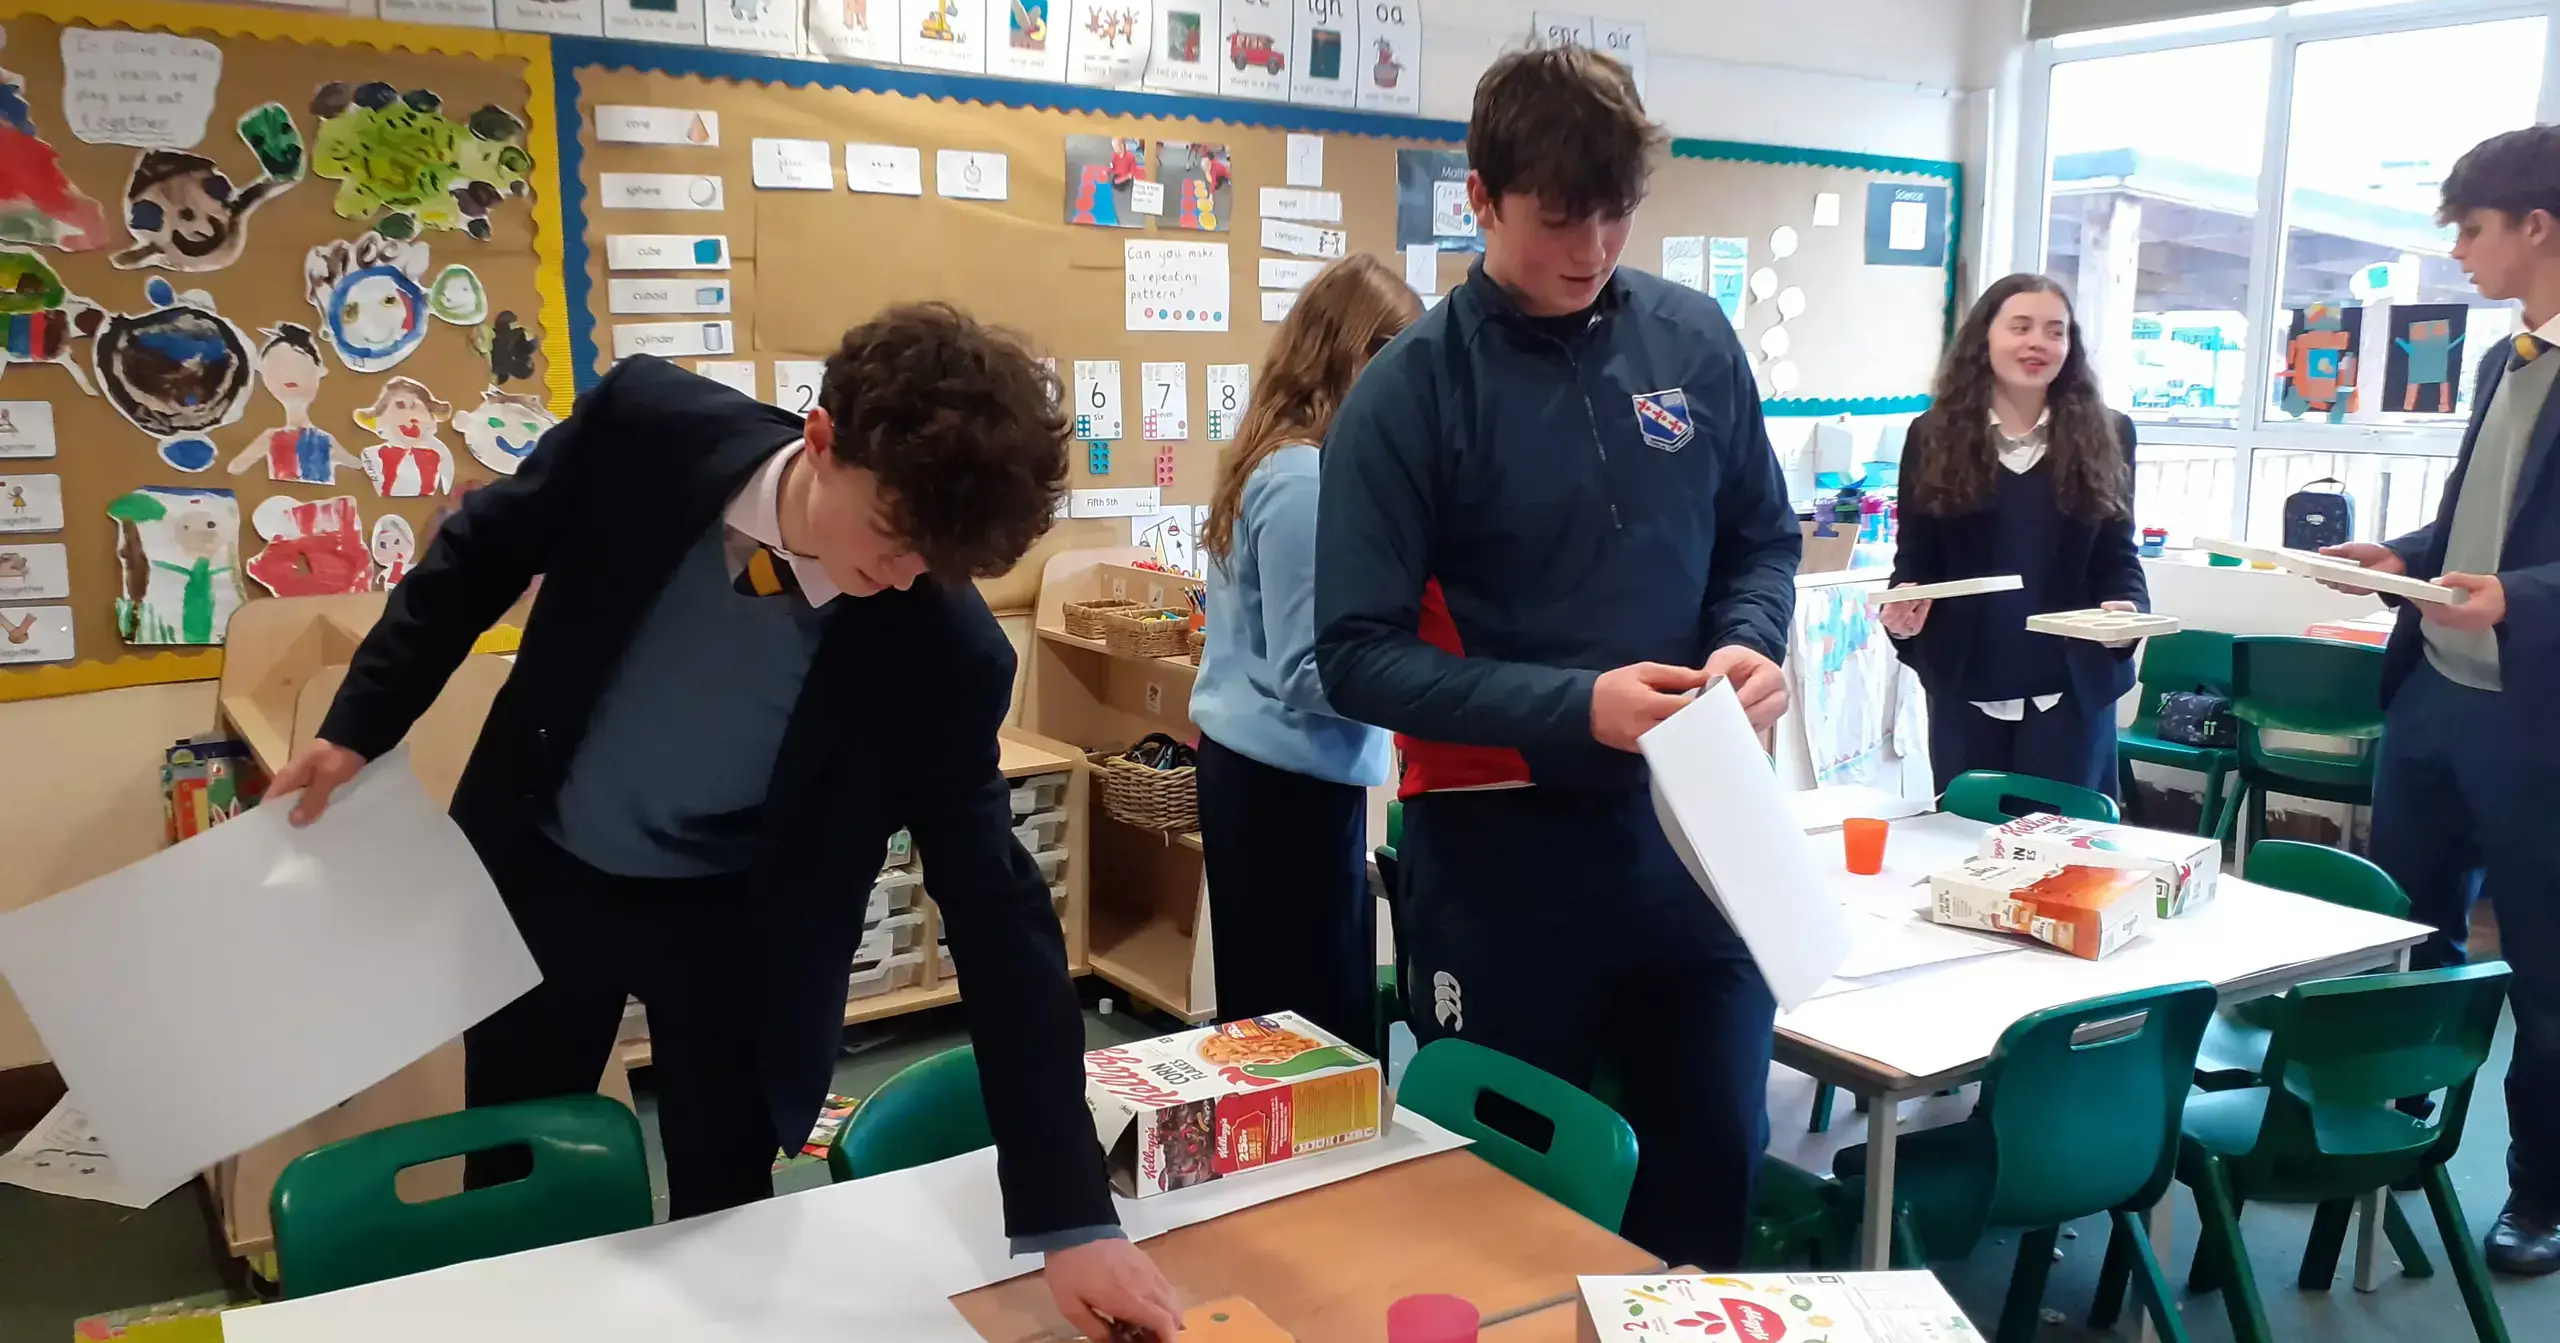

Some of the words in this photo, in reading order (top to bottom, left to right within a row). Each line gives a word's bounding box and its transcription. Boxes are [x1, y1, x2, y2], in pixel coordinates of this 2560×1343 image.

[1127, 246, 1151, 260] Can
[1158, 250, 1182, 268] you
[1188, 249, 1214, 260] make
[1128, 273, 1136, 282] a
[1142, 270, 1199, 286] repeating
[1130, 287, 1185, 305] pattern?
[795, 384, 815, 413] 2
[1091, 381, 1106, 409] 6
[1156, 382, 1172, 410] 7
[1221, 384, 1237, 411] 8
[1086, 498, 1105, 508] Fifth
[1106, 497, 1119, 507] 5th
[1148, 1060, 1191, 1086] CORN
[1168, 1057, 1209, 1081] FLAKES
[1141, 1126, 1161, 1180] Kellogg's
